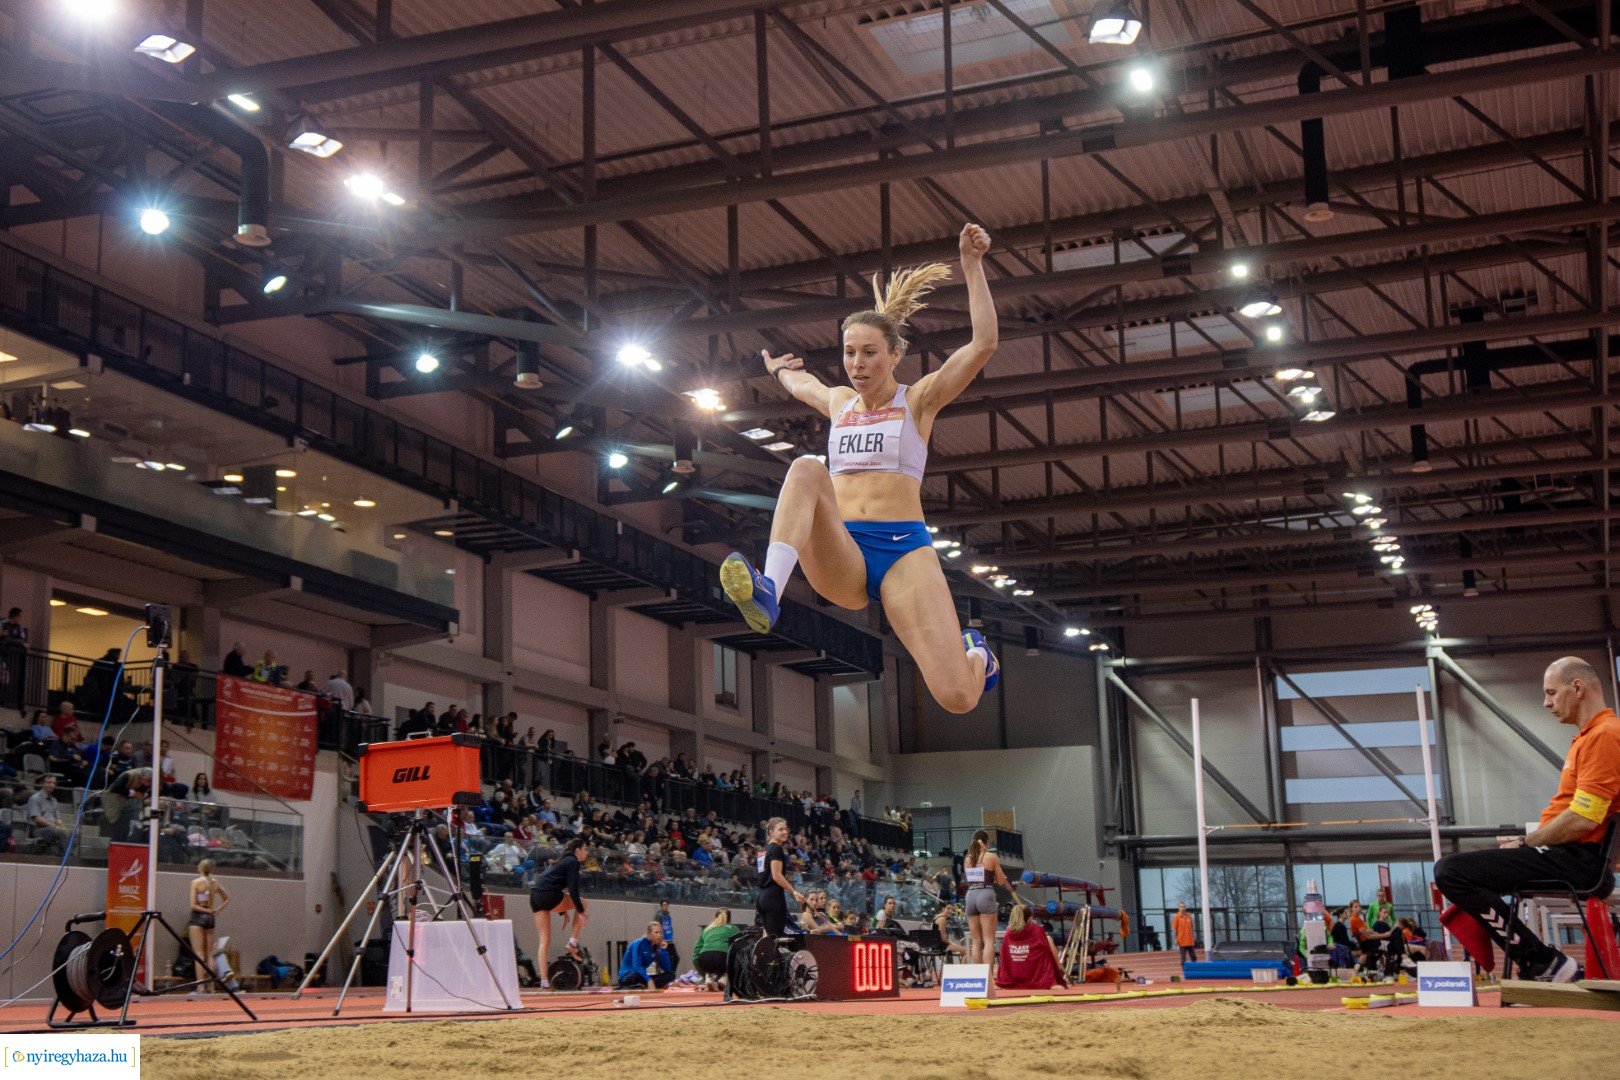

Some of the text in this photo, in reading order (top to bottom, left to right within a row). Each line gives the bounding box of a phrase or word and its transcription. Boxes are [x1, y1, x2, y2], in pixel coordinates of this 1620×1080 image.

[838, 433, 884, 455] EKLER
[392, 765, 430, 784] GILL
[855, 943, 893, 992] 0.00
[955, 981, 984, 990] polanik
[1434, 980, 1467, 989] polanik
